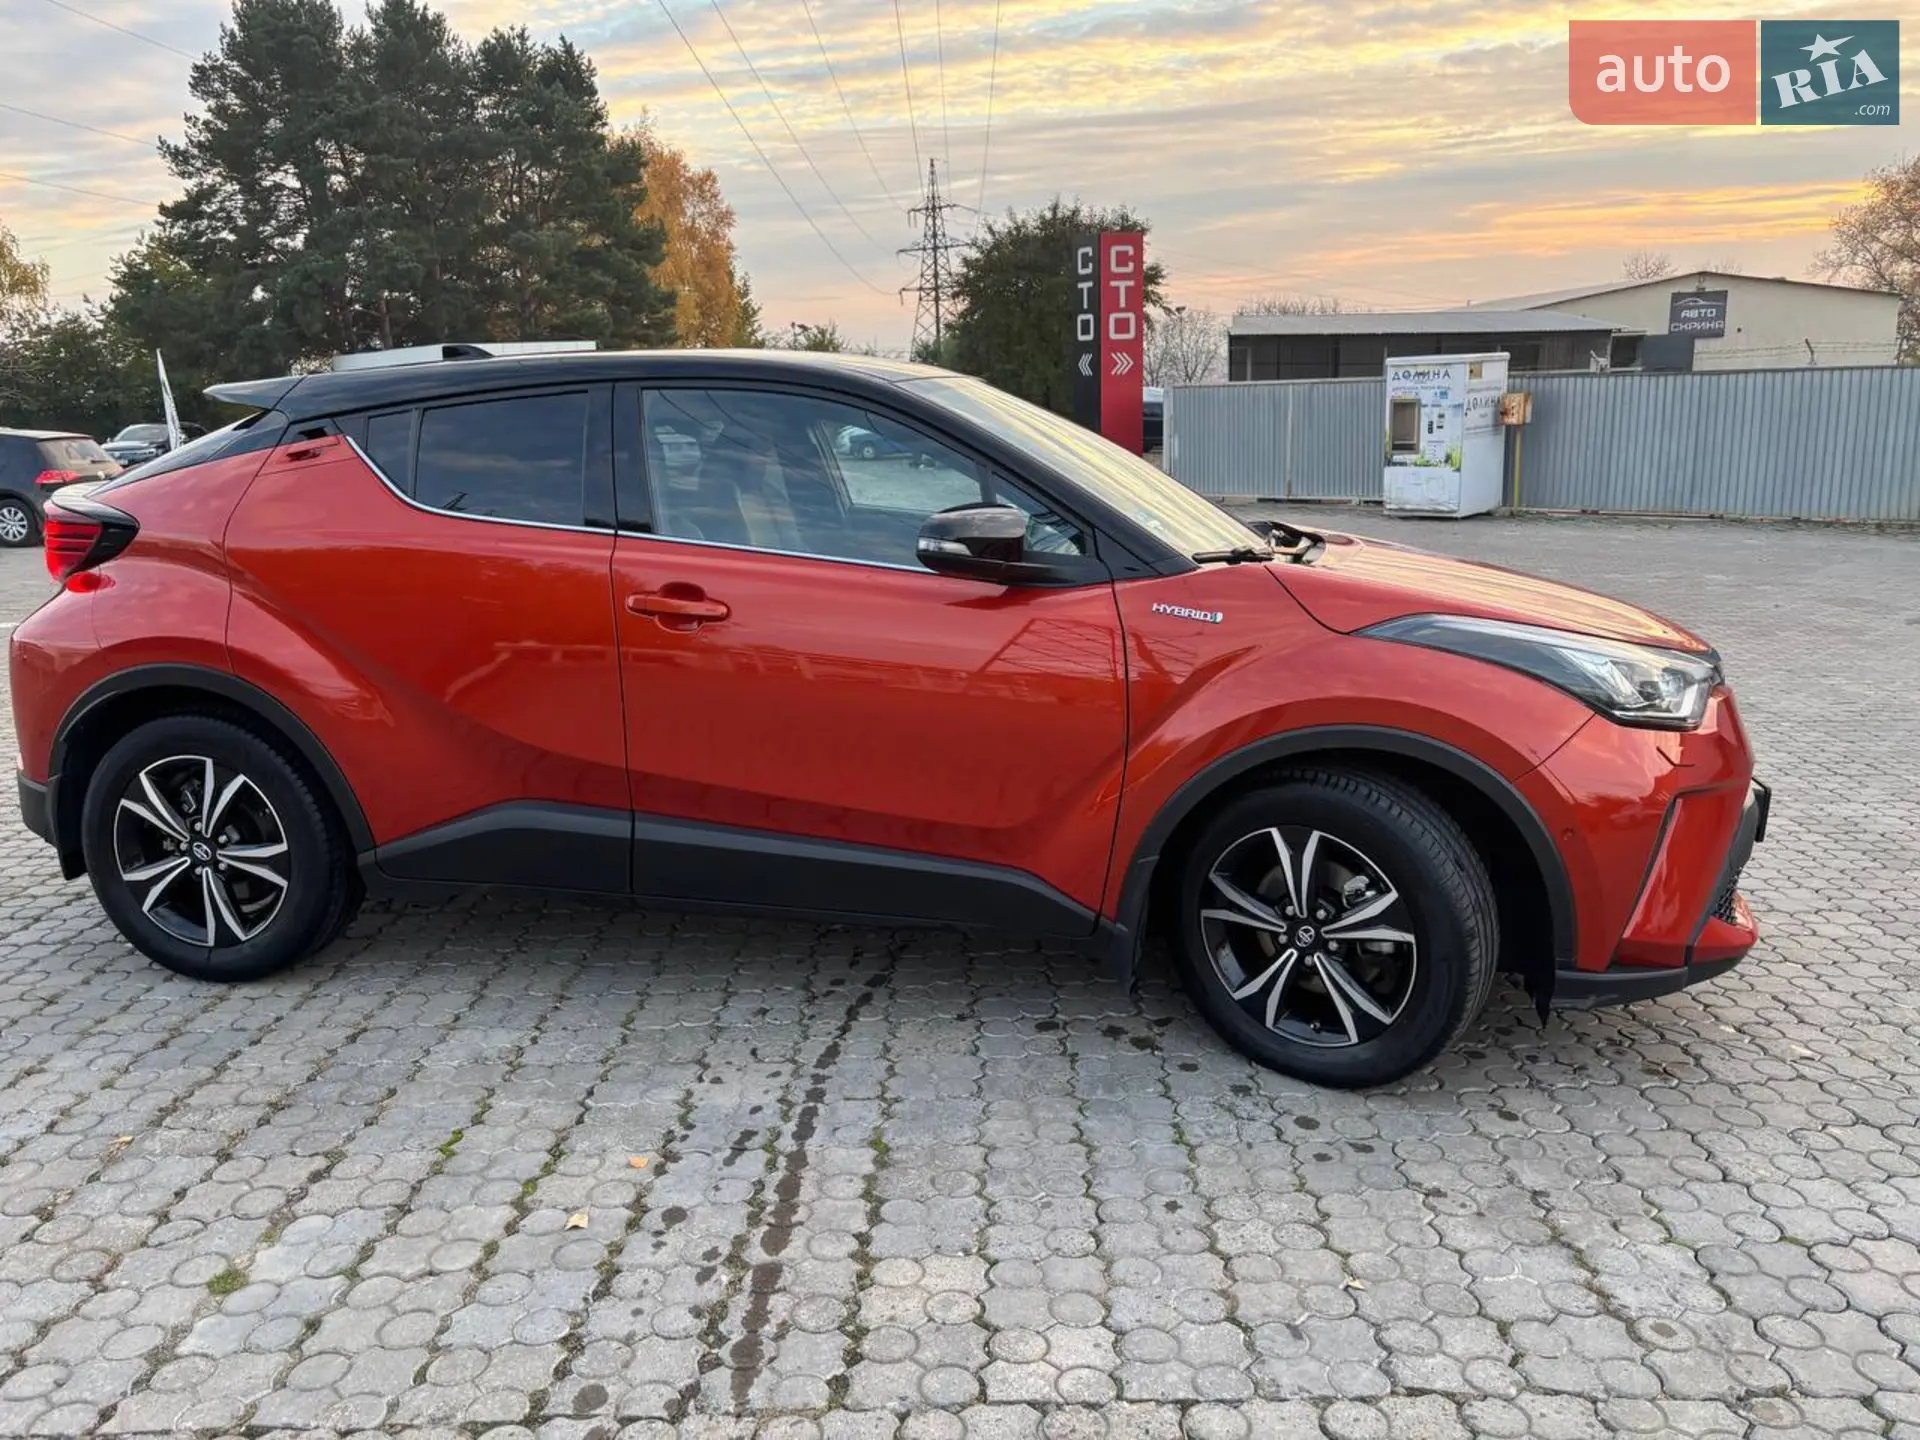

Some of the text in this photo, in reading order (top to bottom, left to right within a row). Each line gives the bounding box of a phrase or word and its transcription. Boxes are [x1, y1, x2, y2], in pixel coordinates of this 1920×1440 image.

[1077, 246, 1095, 342] СТО
[1109, 245, 1136, 340] СТО
[1681, 308, 1716, 319] АВТО
[1152, 602, 1214, 622] HYBRID
